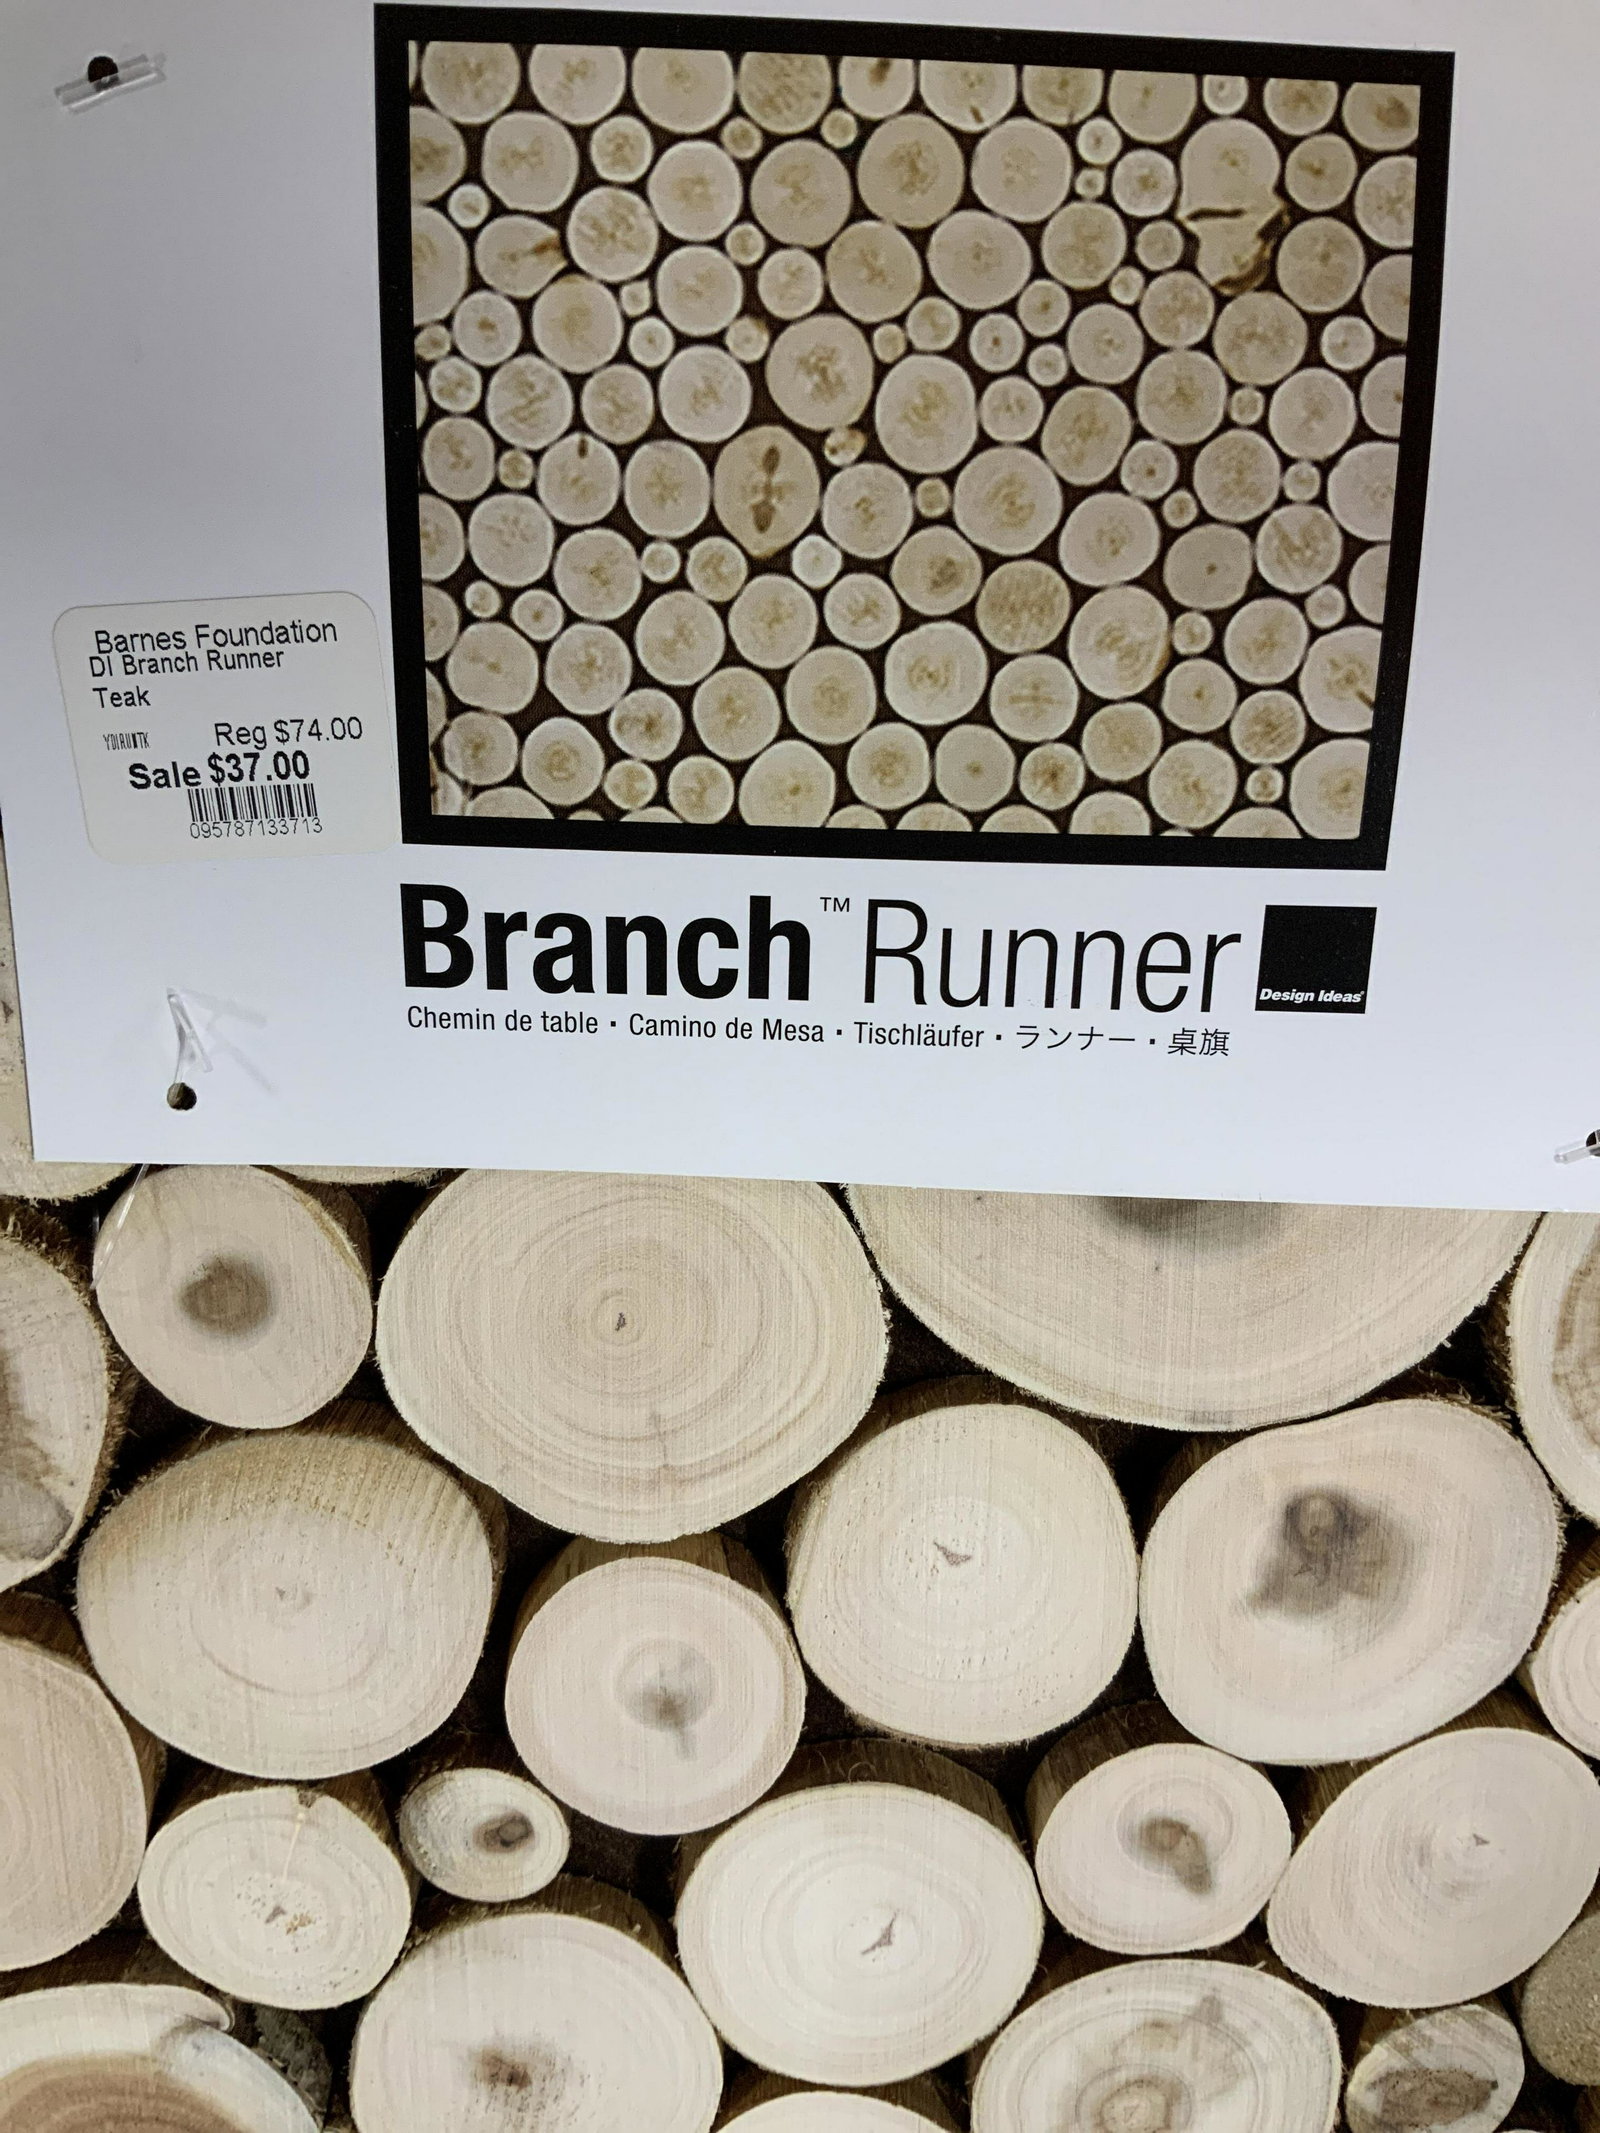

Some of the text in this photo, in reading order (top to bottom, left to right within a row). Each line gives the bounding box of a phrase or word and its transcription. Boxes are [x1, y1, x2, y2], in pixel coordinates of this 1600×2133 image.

[94, 620, 338, 654] Barnes Foundation
[122, 651, 199, 676] Branch
[206, 650, 285, 671] Runner
[92, 686, 151, 708] Teak
[214, 716, 363, 750] Reg $74.00
[129, 750, 310, 789] Sale $37.00
[190, 816, 323, 839] 095787133713
[400, 883, 811, 1001] Branch
[864, 898, 1242, 1014] Runner
[1259, 988, 1315, 1004] Design
[407, 1005, 985, 1048] Chemin de table Camino de Mesa Tischläufer
[1016, 1025, 1136, 1051] ランナー
[1167, 1027, 1231, 1057] 桌旗
